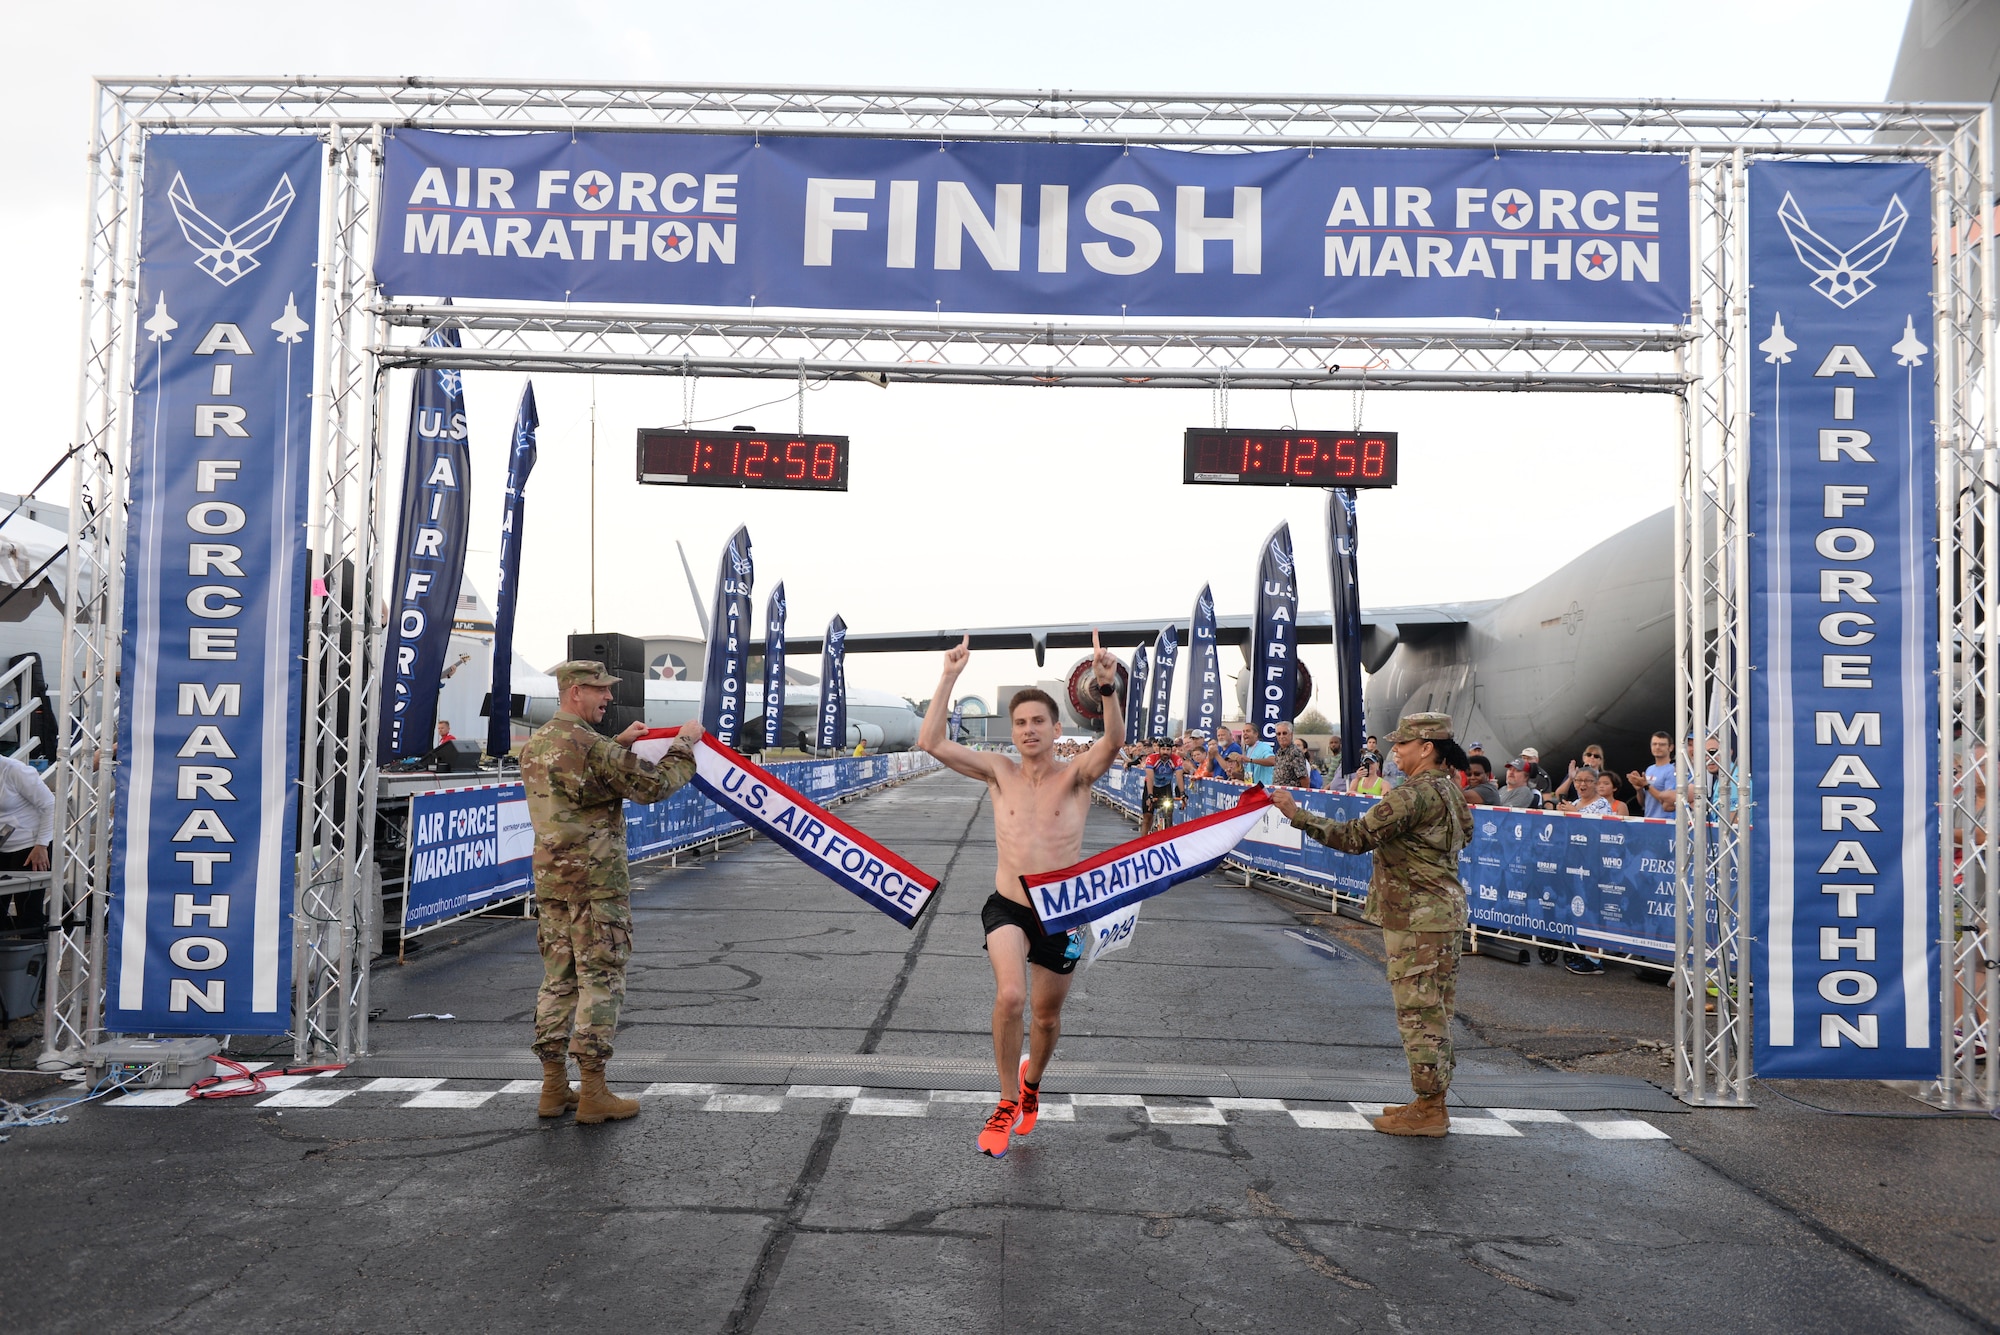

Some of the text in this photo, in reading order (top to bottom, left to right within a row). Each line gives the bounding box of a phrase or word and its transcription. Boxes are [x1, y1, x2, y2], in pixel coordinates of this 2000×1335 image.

[409, 167, 738, 214] AIR FORCE
[1326, 186, 1660, 233] AIR FORCE
[403, 213, 737, 264] MARATHON
[803, 177, 1262, 276] FINISH
[1324, 236, 1660, 283] MARATHON
[415, 457, 456, 557] AIR
[455, 622, 475, 630] AFMC
[727, 602, 739, 652] AIR
[1268, 606, 1291, 659] AIR
[168, 322, 255, 1014] AIR FORCE MARATHON
[1204, 645, 1216, 683] AIR
[718, 660, 738, 747] FORCE
[766, 680, 779, 744] FORCE
[1200, 689, 1215, 741] FORC
[1262, 667, 1284, 747] FORC
[1814, 344, 1881, 1049] AIR FORCE MARATHON
[1153, 704, 1167, 740] FOR
[416, 804, 496, 846] AIR FORCE
[722, 767, 922, 910] U.S. AIR FORCE
[413, 838, 496, 884] MARATHON
[1040, 843, 1181, 917] MARATHON
[407, 894, 467, 922] usafmarathon.com
[1480, 884, 1498, 899] Dole
[1474, 908, 1575, 936] usafmarathon.com
